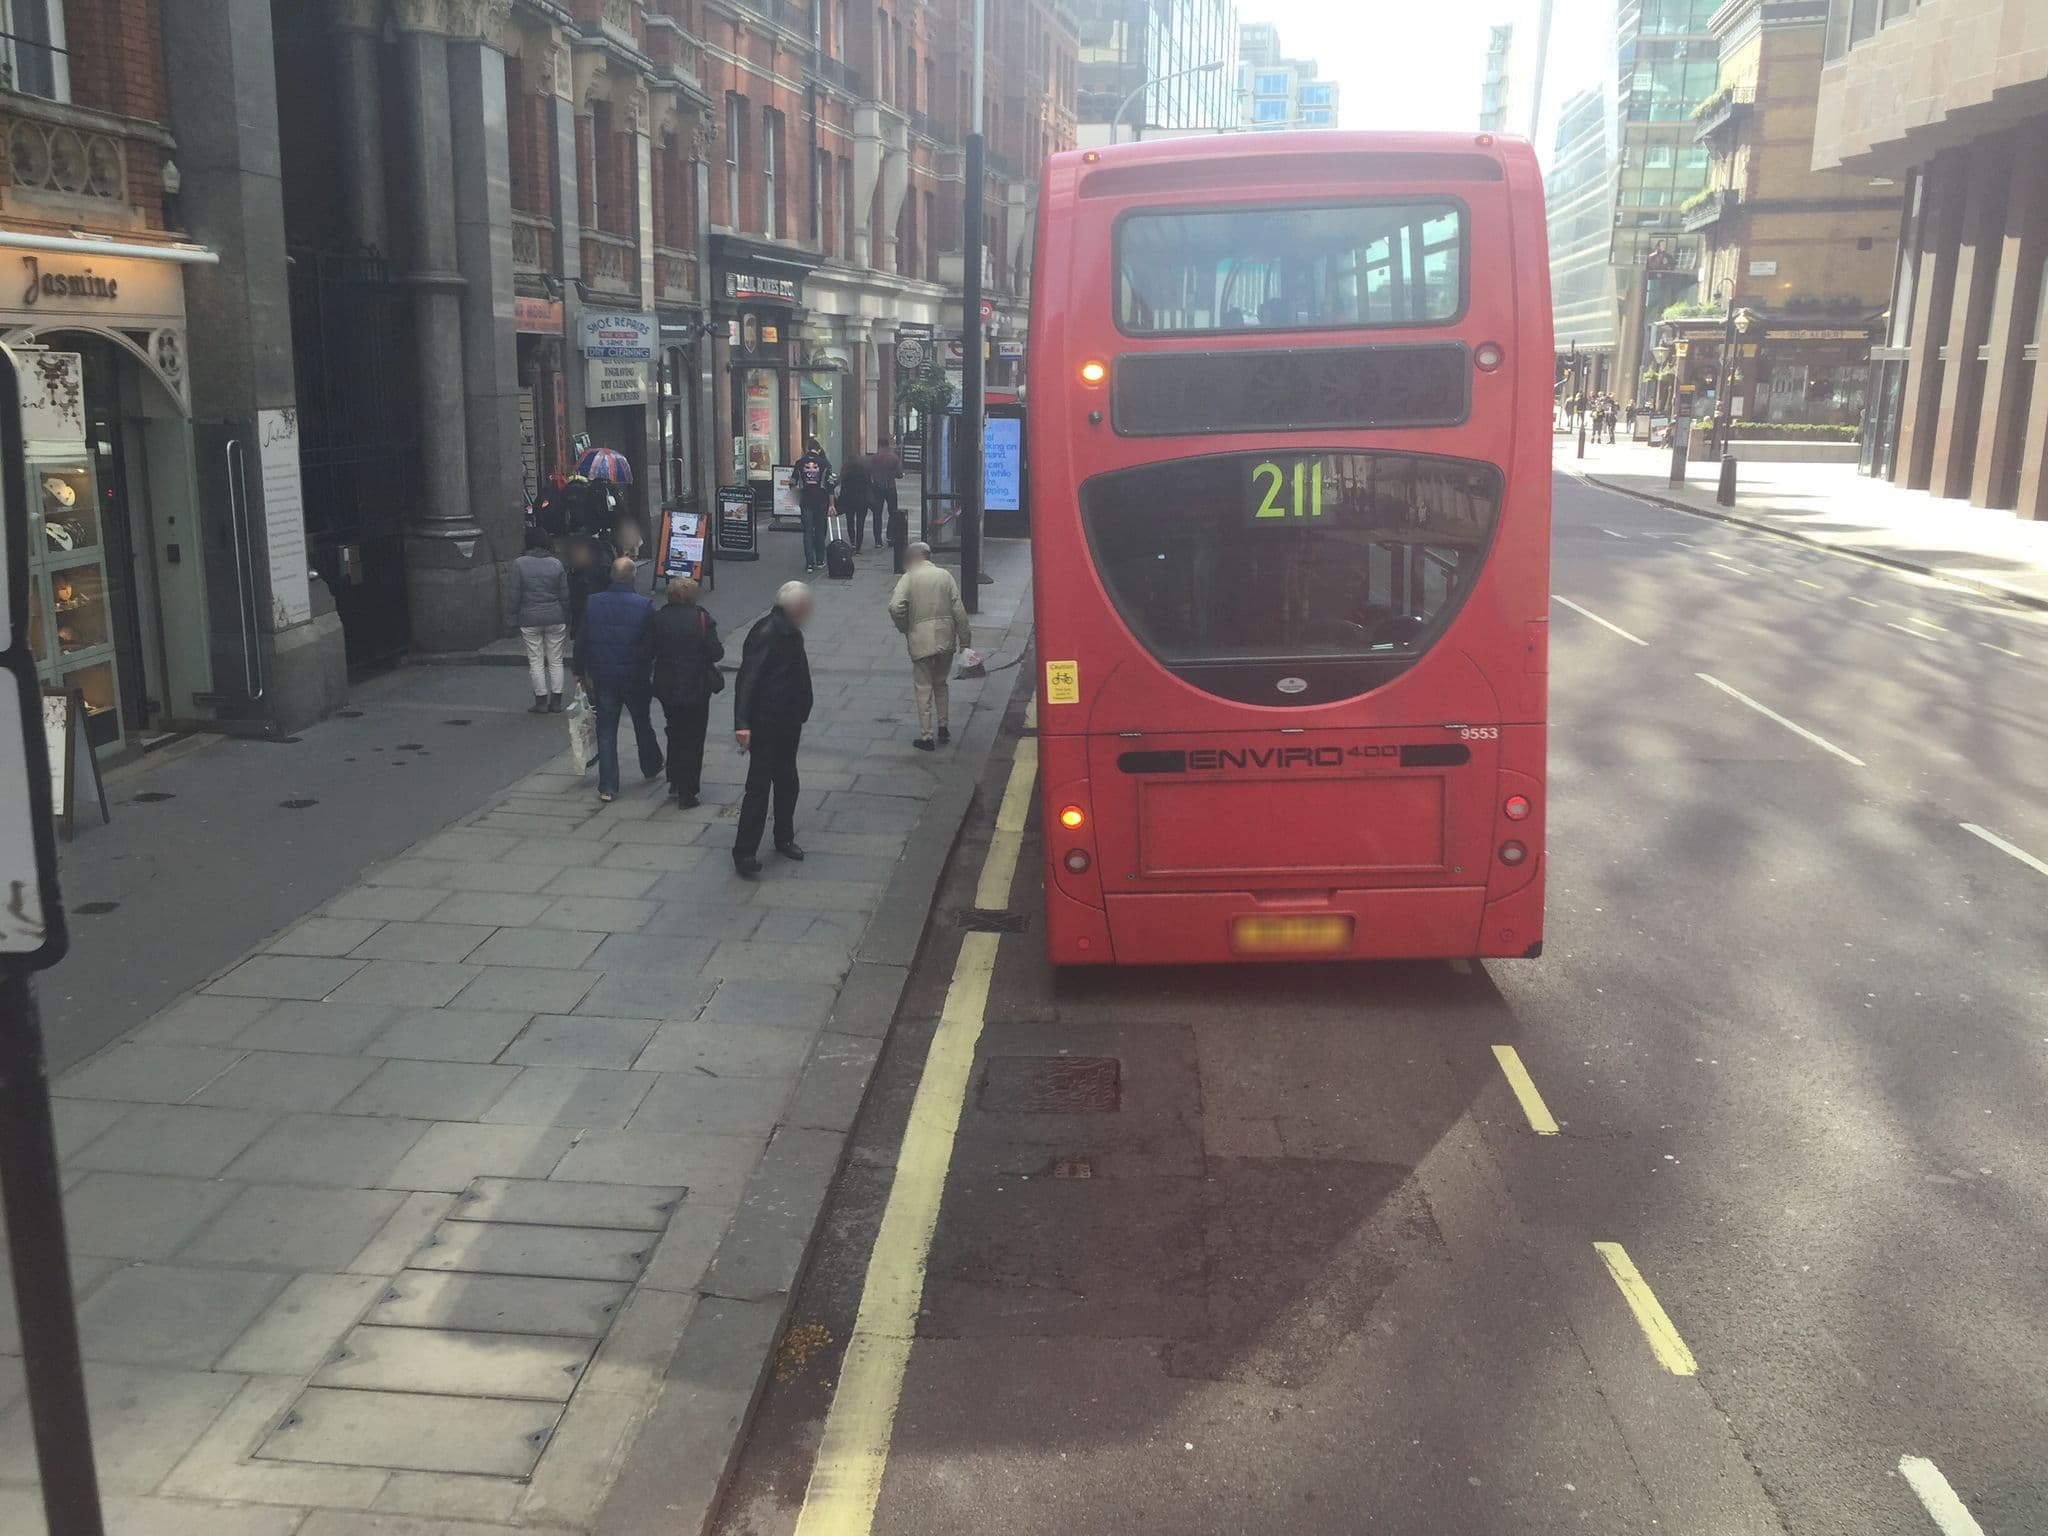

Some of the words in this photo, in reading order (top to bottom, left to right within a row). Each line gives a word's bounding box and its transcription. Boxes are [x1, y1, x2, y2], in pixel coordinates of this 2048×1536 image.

[22, 256, 117, 305] Jasmine
[737, 274, 755, 292] MAIL
[757, 277, 778, 294] BOXES
[586, 317, 612, 334] SHOE
[614, 317, 650, 335] REPAIRS
[589, 347, 604, 357] DRY
[607, 347, 650, 358] CLEANING
[601, 380, 612, 389] DRY
[1252, 462, 1321, 517] 211
[1461, 728, 1498, 740] 9553
[1190, 747, 1343, 769] ENVIRO
[1347, 745, 1398, 758] 400
